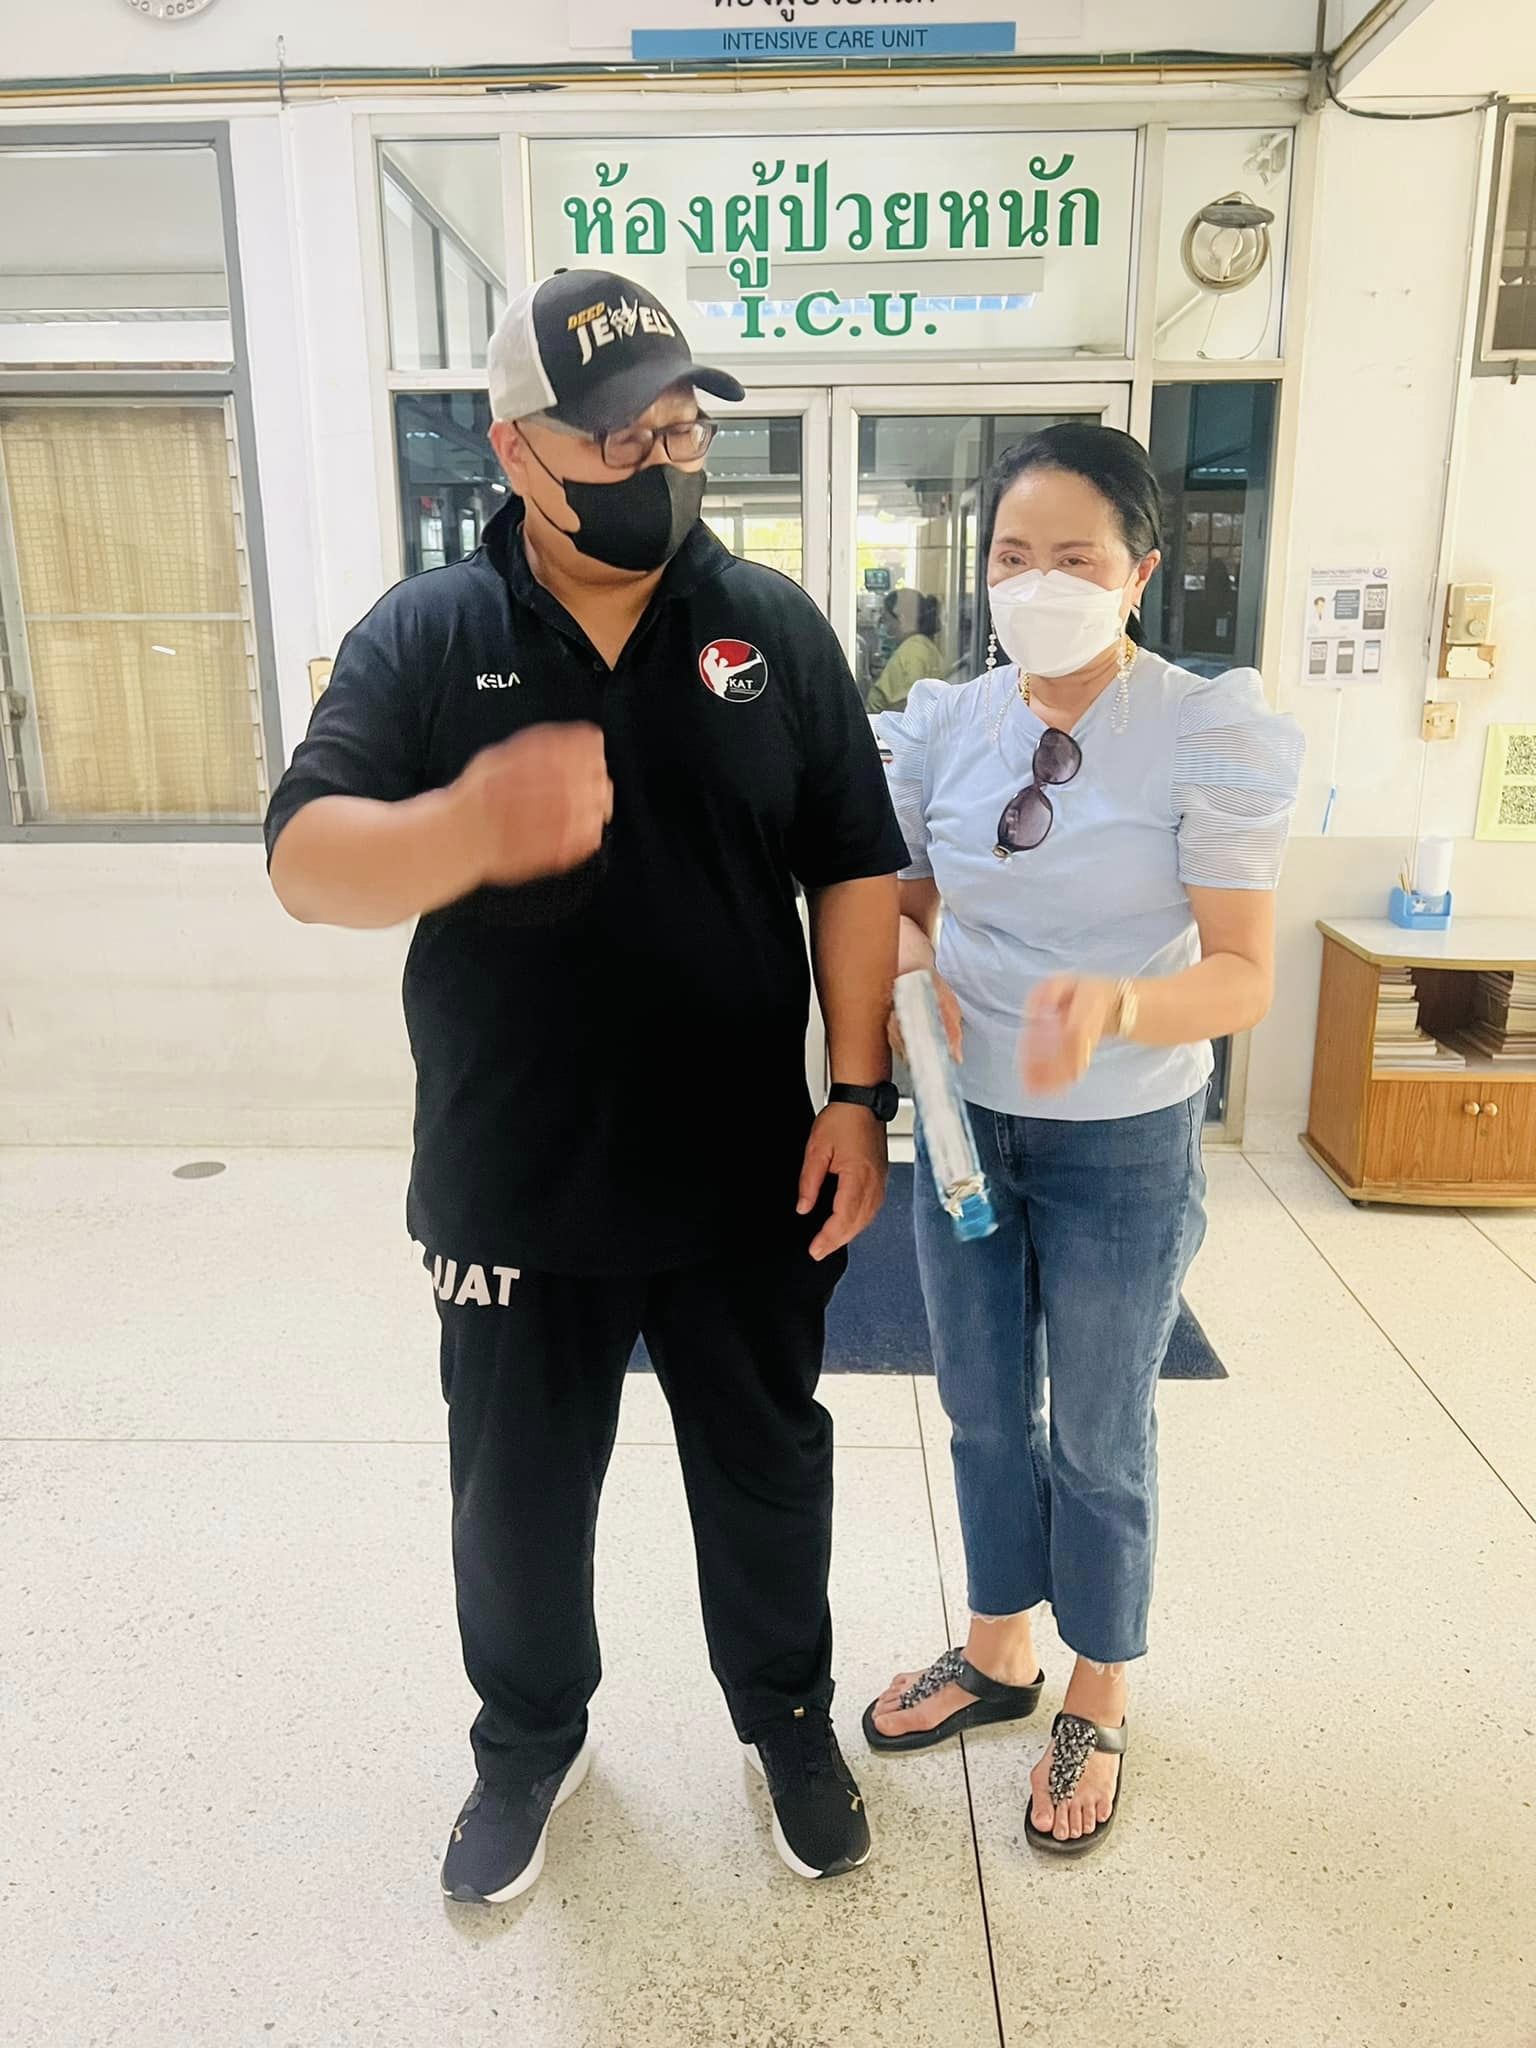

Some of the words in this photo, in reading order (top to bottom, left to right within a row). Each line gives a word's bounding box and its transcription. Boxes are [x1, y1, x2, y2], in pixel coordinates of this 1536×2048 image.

[722, 31, 818, 51] INTENSIVE
[825, 30, 875, 49] CARE
[881, 29, 929, 48] UNIT
[563, 153, 1102, 290] ห้องผู้ป่วยหนัก
[740, 289, 938, 339] I.C.U.
[476, 671, 521, 690] KELA
[728, 678, 754, 689] KAT
